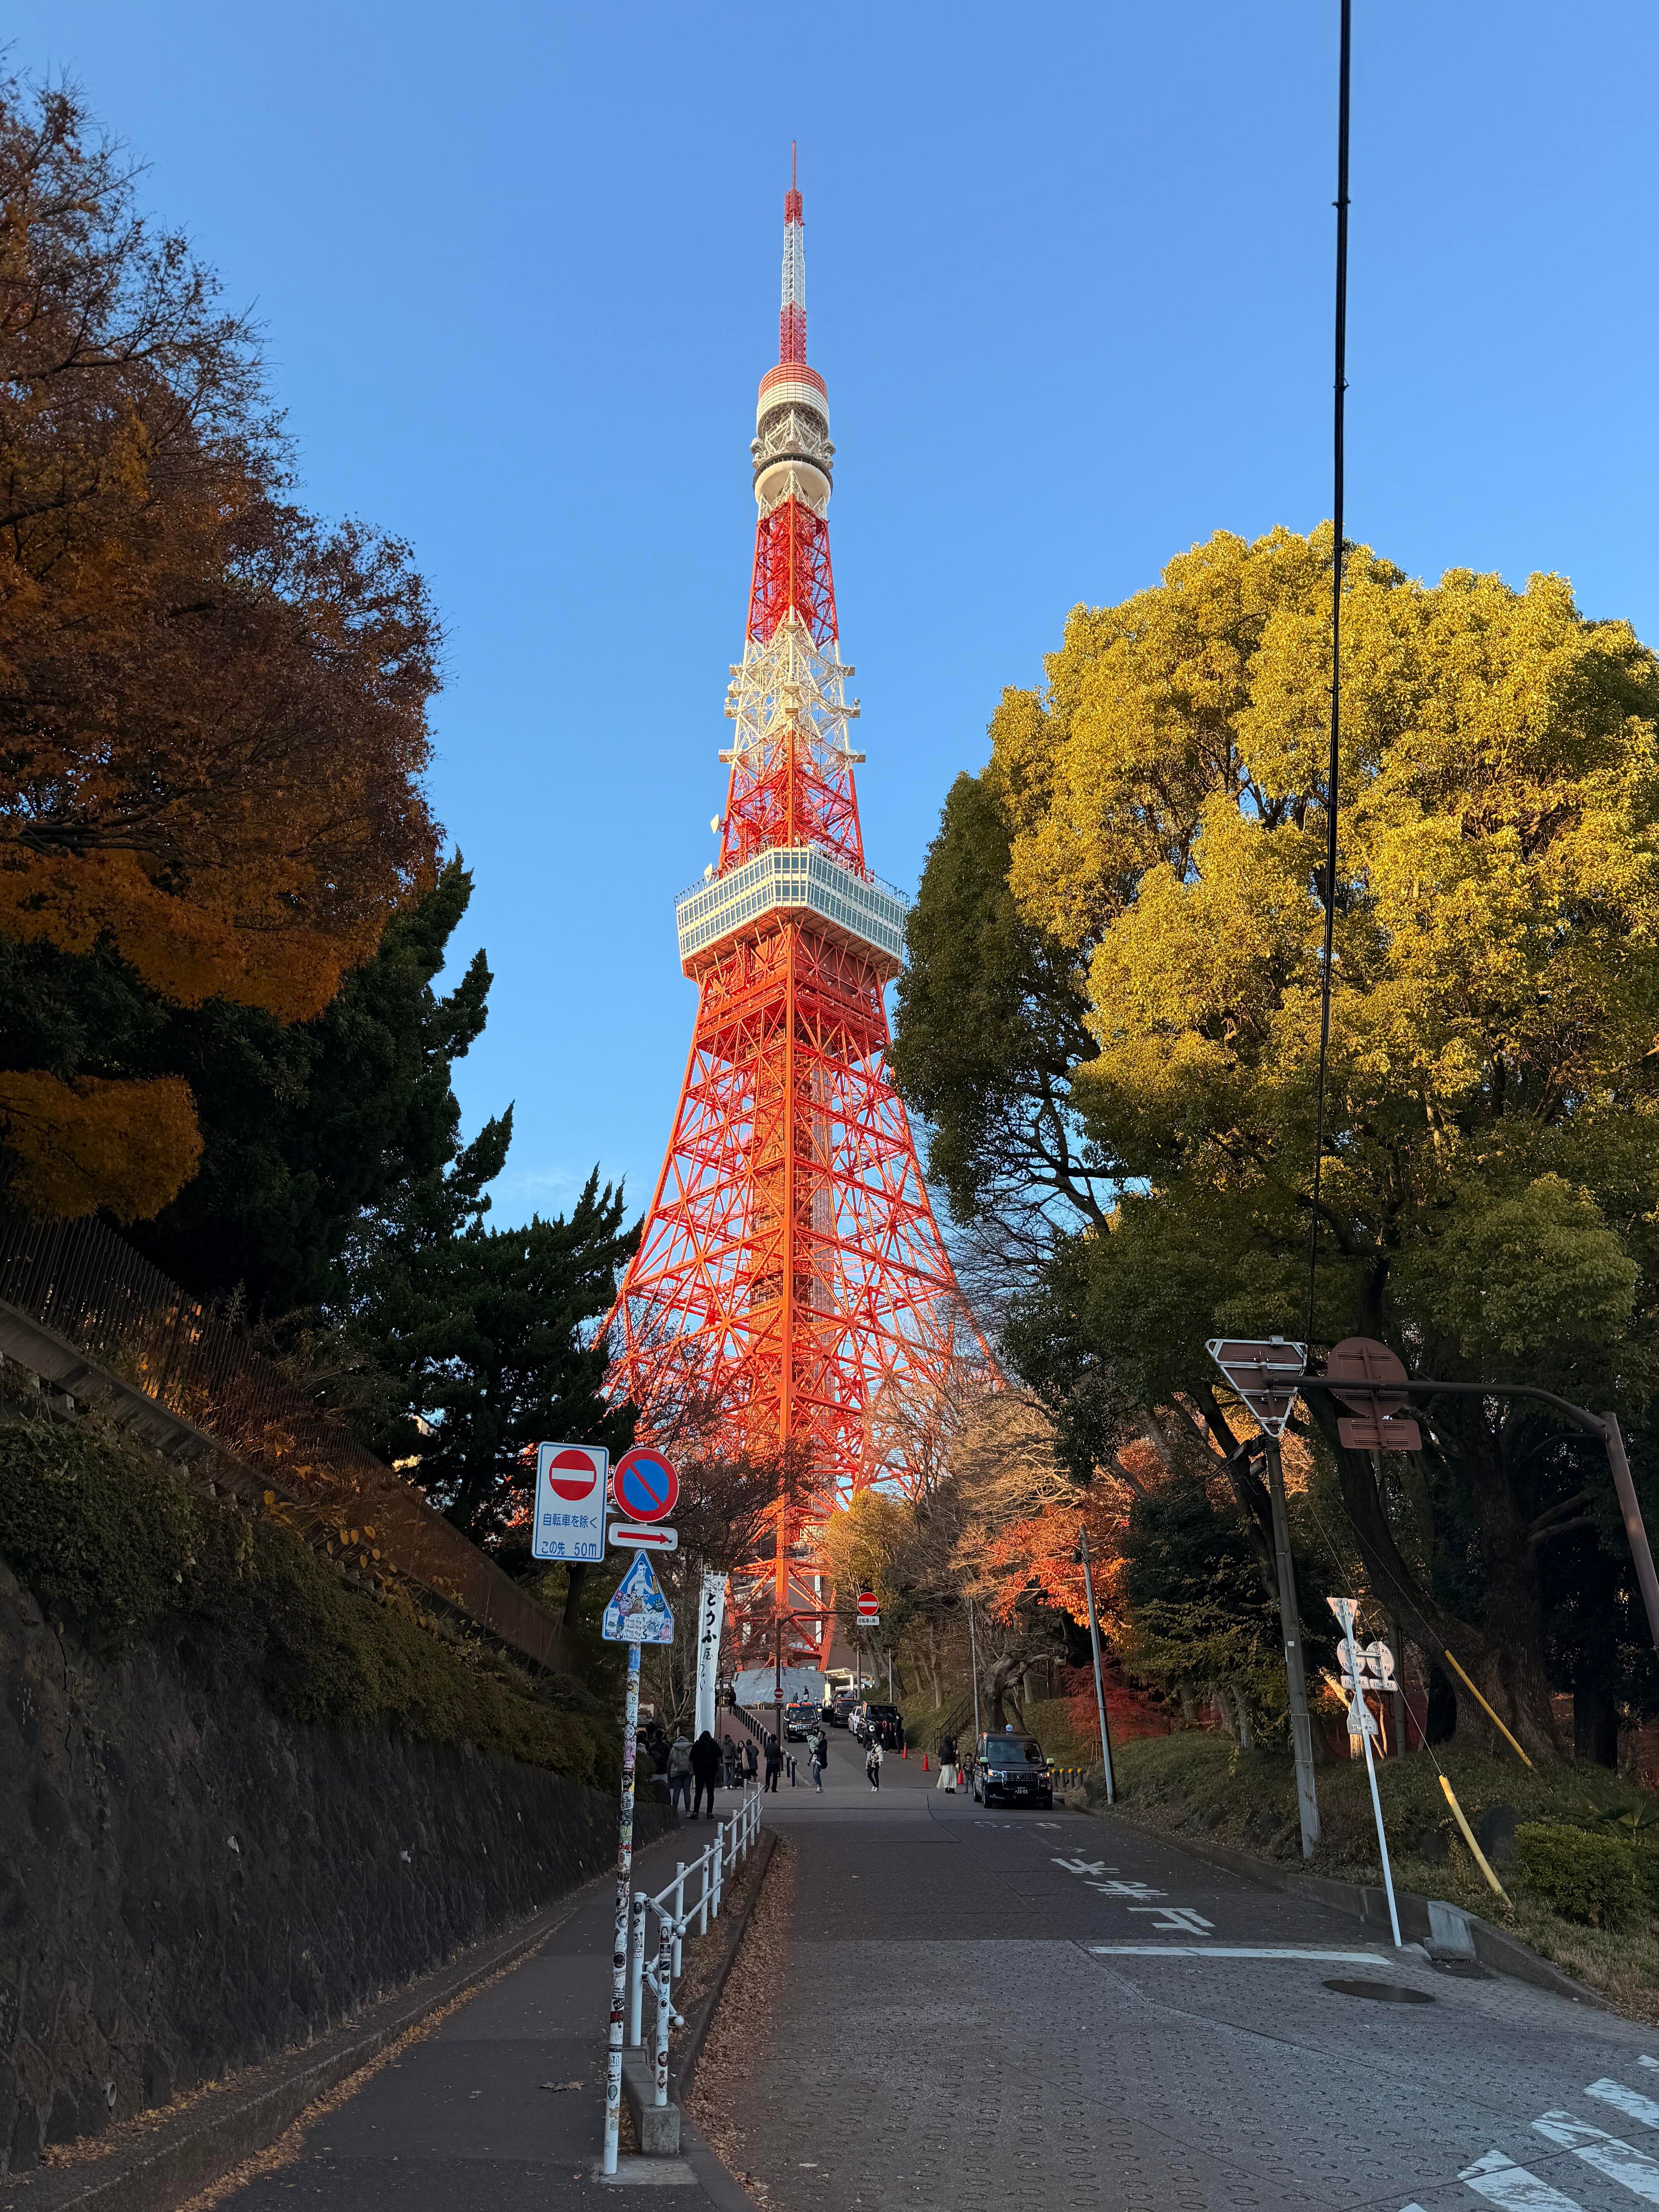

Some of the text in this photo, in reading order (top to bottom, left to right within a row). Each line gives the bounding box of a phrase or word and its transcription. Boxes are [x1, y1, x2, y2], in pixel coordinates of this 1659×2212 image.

[543, 1513, 597, 1529] 自転車を除く
[541, 1541, 597, 1557] この先 50m
